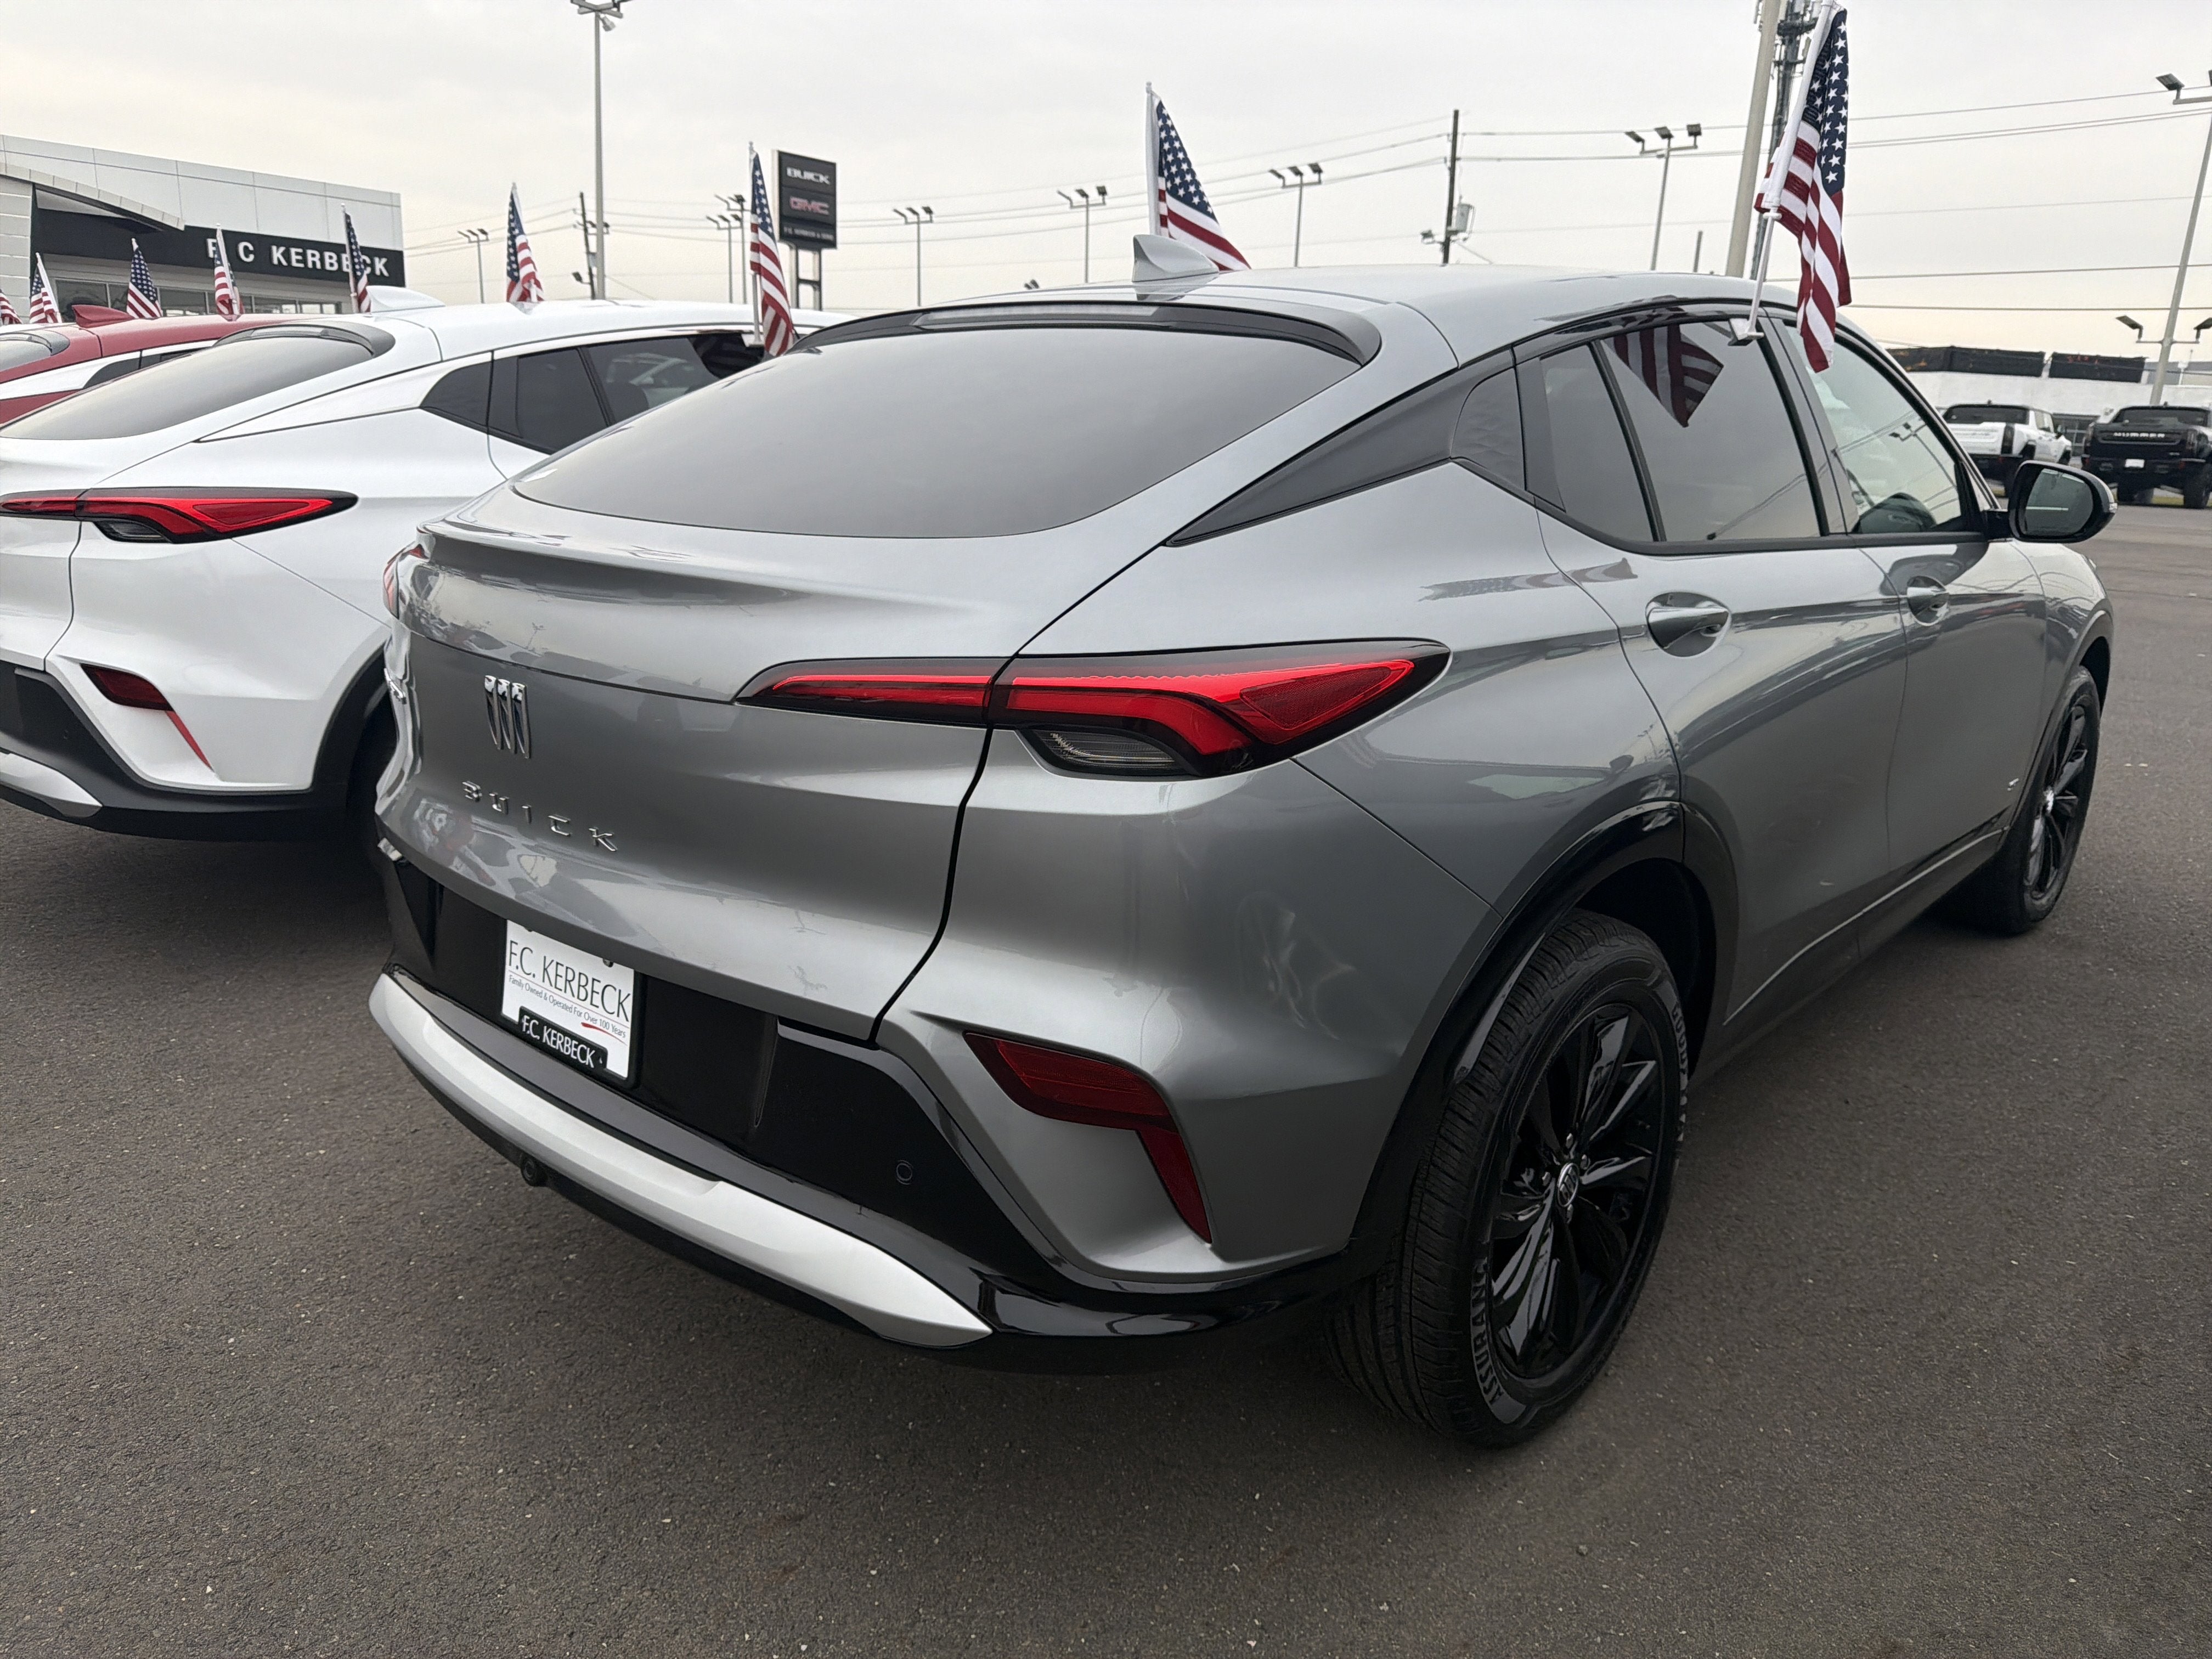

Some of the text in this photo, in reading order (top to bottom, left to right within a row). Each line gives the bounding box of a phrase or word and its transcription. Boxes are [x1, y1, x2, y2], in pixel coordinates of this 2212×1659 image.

[238, 241, 254, 262] C
[271, 245, 389, 277] KERBECK
[462, 781, 618, 852] BUICK
[508, 939, 631, 1023] F.C. KERBECK
[509, 974, 626, 1039] Family Owned & Operated For Over 100 Years
[522, 1014, 596, 1068] F.C. KERBECK
